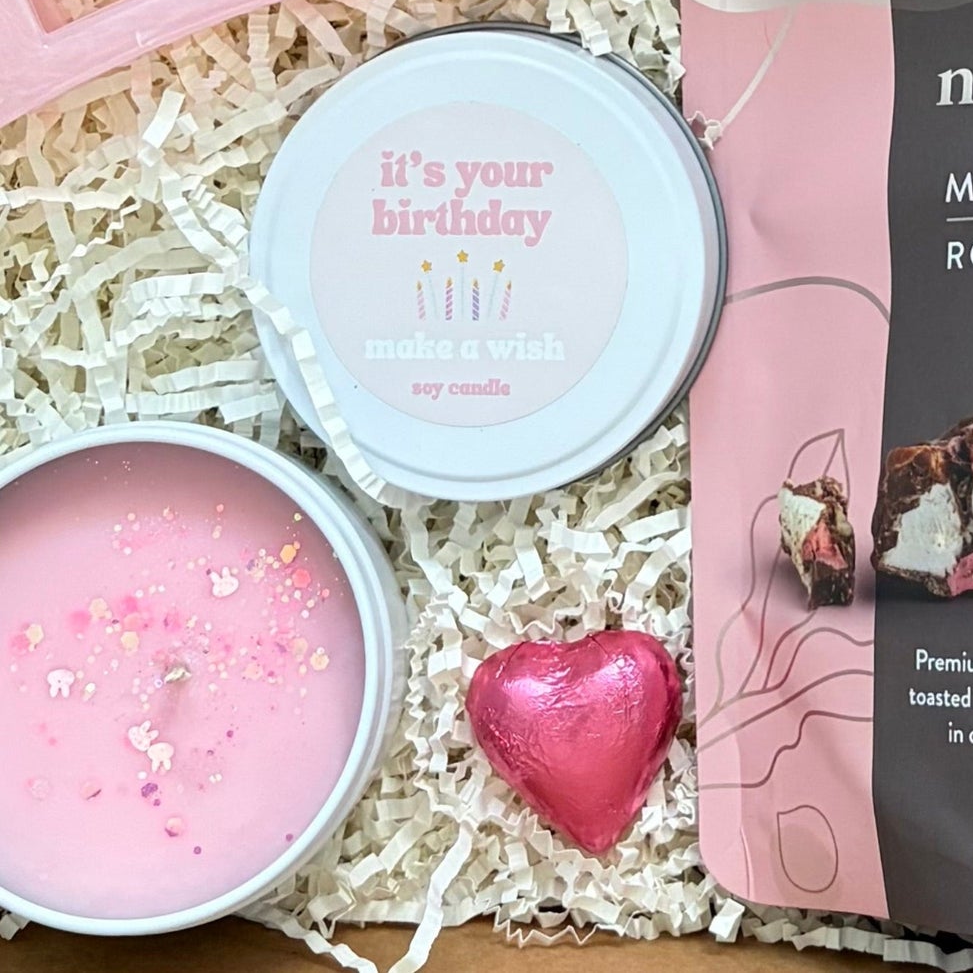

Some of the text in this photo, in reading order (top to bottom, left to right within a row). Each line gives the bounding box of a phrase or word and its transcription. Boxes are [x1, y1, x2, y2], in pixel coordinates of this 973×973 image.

[380, 150, 554, 198] it's your
[371, 198, 552, 247] birthday
[365, 331, 565, 361] make a wish
[411, 378, 511, 400] soy candle
[909, 687, 971, 708] toasted
[948, 721, 964, 743] in
